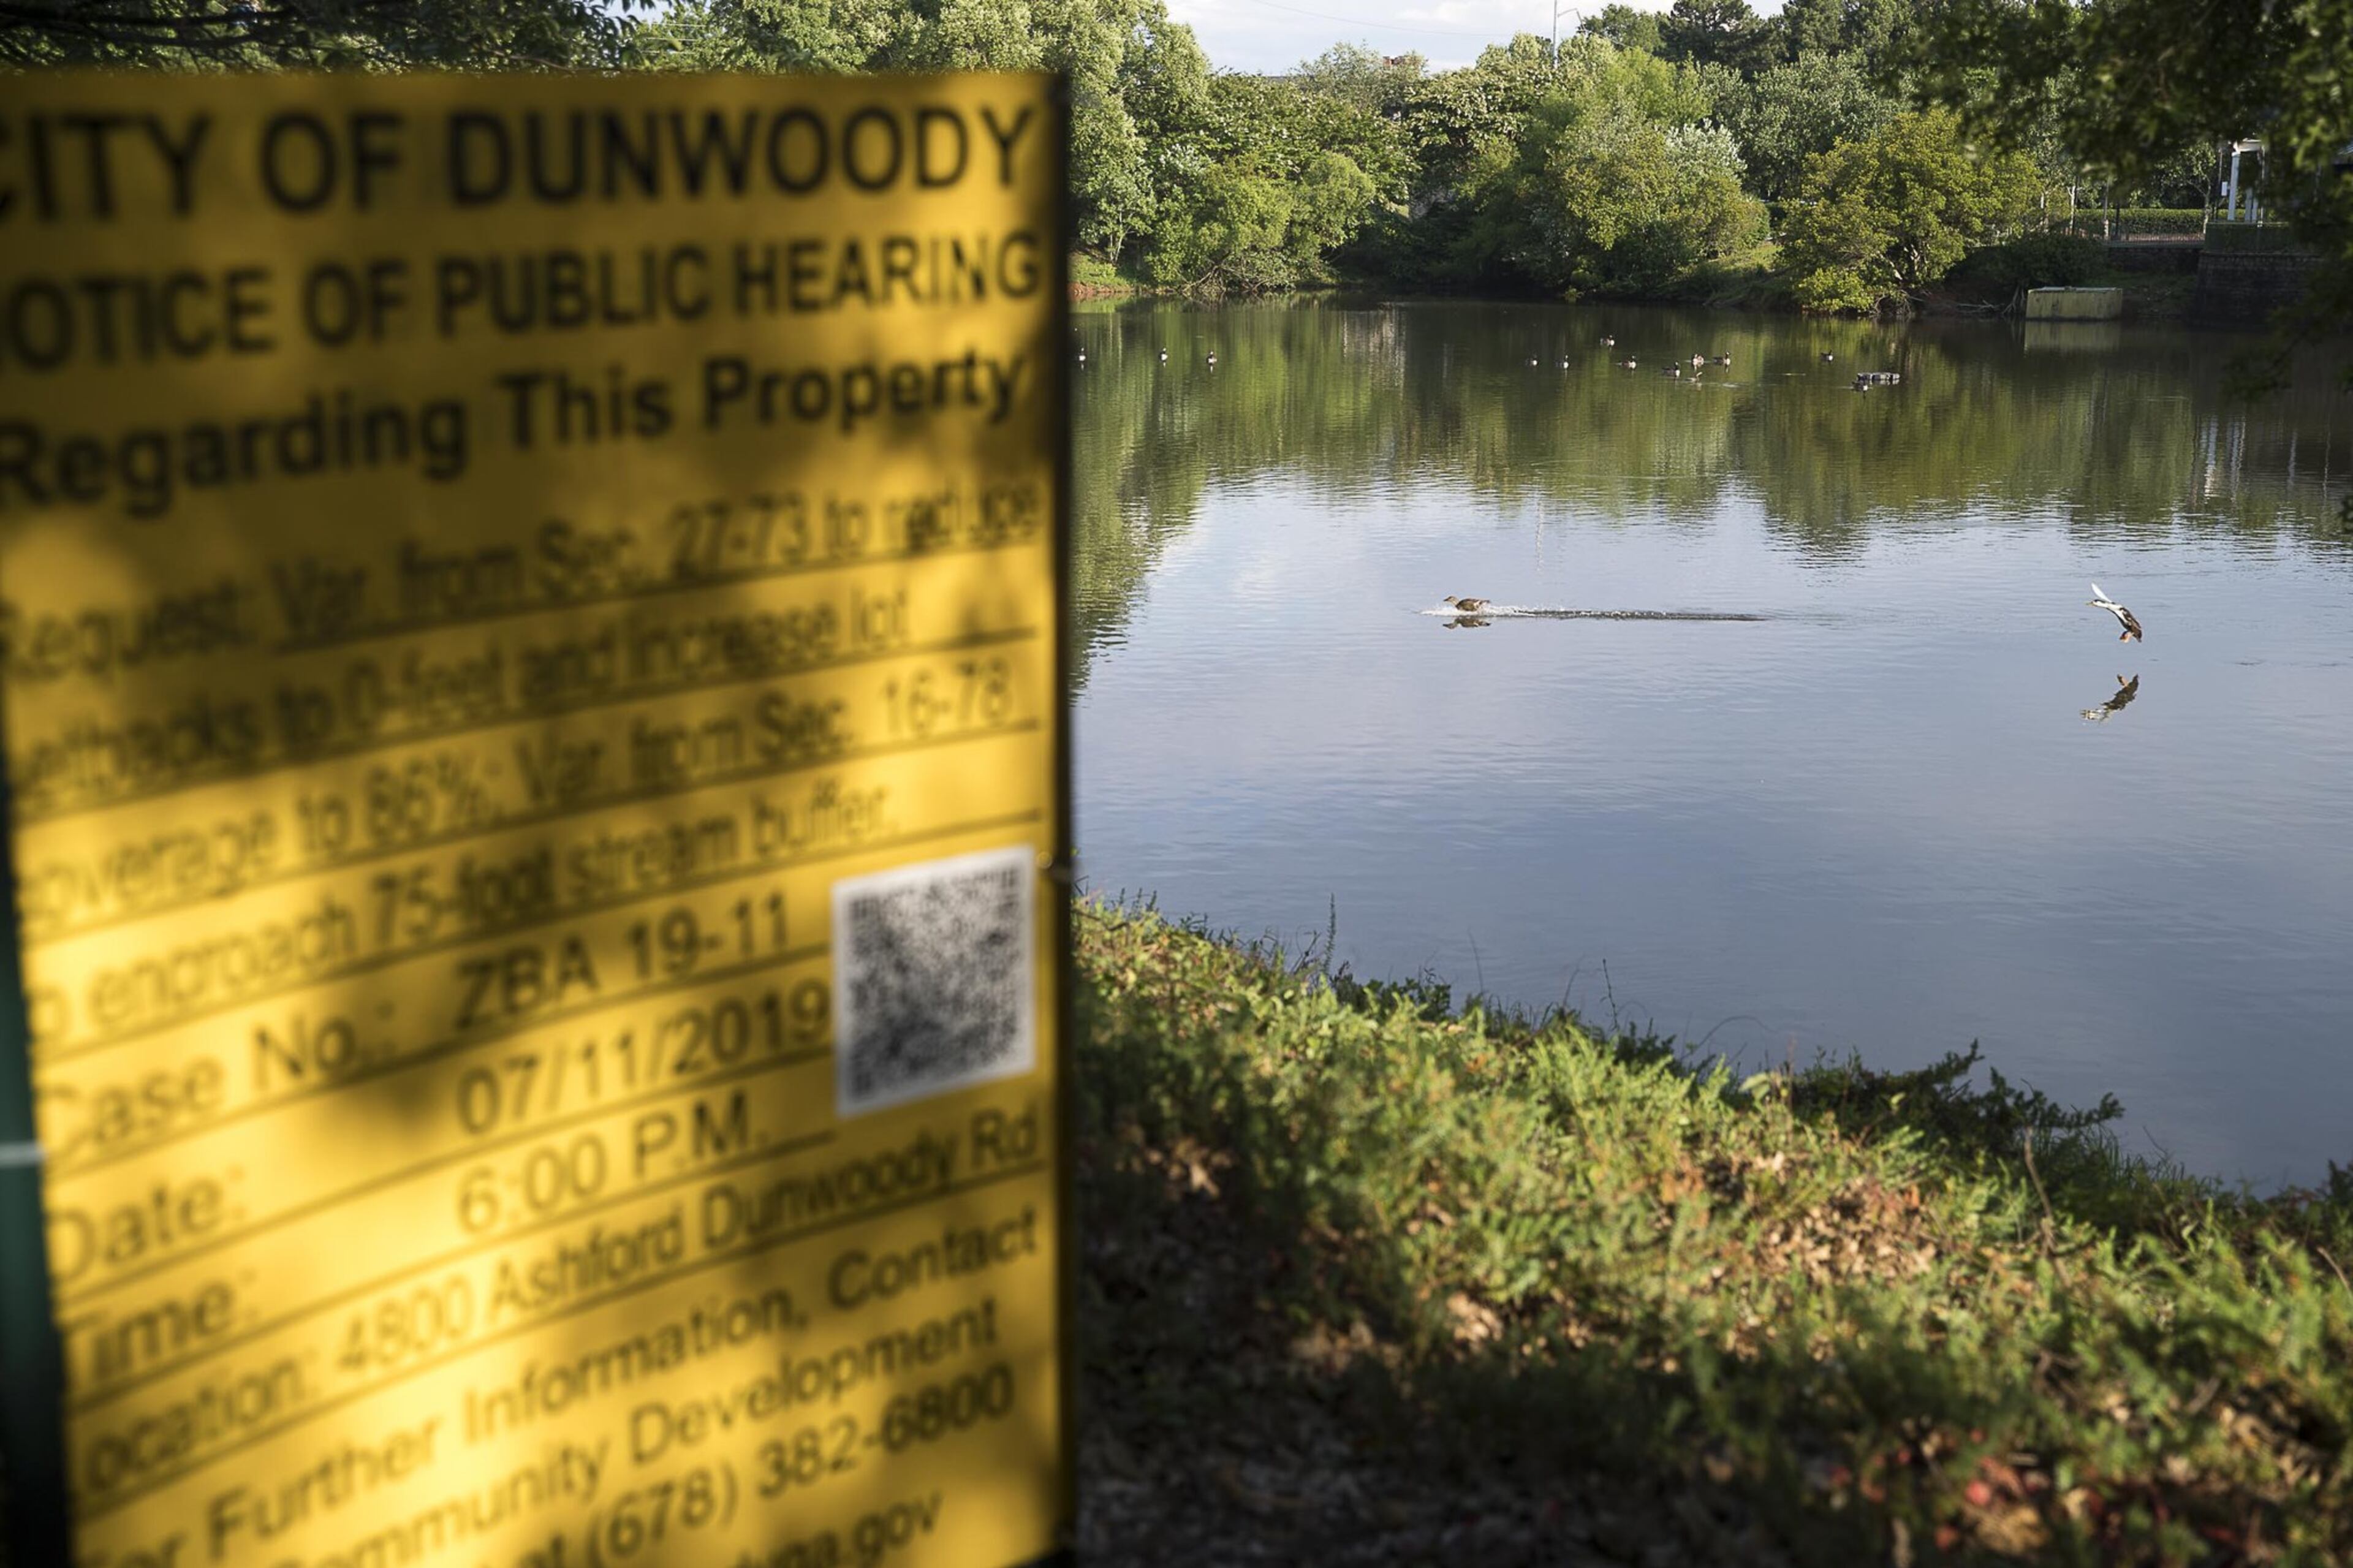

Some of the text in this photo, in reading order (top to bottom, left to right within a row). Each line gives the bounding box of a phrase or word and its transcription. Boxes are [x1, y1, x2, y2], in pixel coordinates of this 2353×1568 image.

[0, 104, 1036, 222] ITY OF DUNWOODY
[6, 227, 1042, 372] OTICE OF PUBLIC HEARING
[0, 343, 1027, 521] Regarding This Property
[398, 536, 525, 618] from
[667, 491, 813, 576] 27-73
[823, 493, 873, 555] to
[884, 475, 1043, 549] reduce
[274, 676, 335, 749] to
[519, 625, 615, 703] and
[627, 604, 840, 683] increase
[853, 581, 911, 648] lot
[28, 810, 281, 928] overage
[294, 787, 354, 859] to
[630, 714, 743, 787] from
[881, 657, 1011, 739] 16-78
[565, 814, 739, 900] stream
[451, 934, 601, 1035] ZBA
[626, 887, 791, 980] 19-11
[456, 979, 832, 1138] 07/11/2019
[455, 1134, 610, 1236] 6:00
[630, 1088, 770, 1181] P.M.
[85, 1346, 323, 1495] ocation:
[336, 1271, 477, 1374] 4800
[491, 1197, 683, 1315] Ashford
[701, 1126, 963, 1251] Dunwoody
[207, 1417, 442, 1562] Further
[826, 1205, 1039, 1312] Contact
[627, 1295, 1002, 1468] Development
[586, 1460, 738, 1568] (678)
[755, 1360, 1017, 1501] 382-6800
